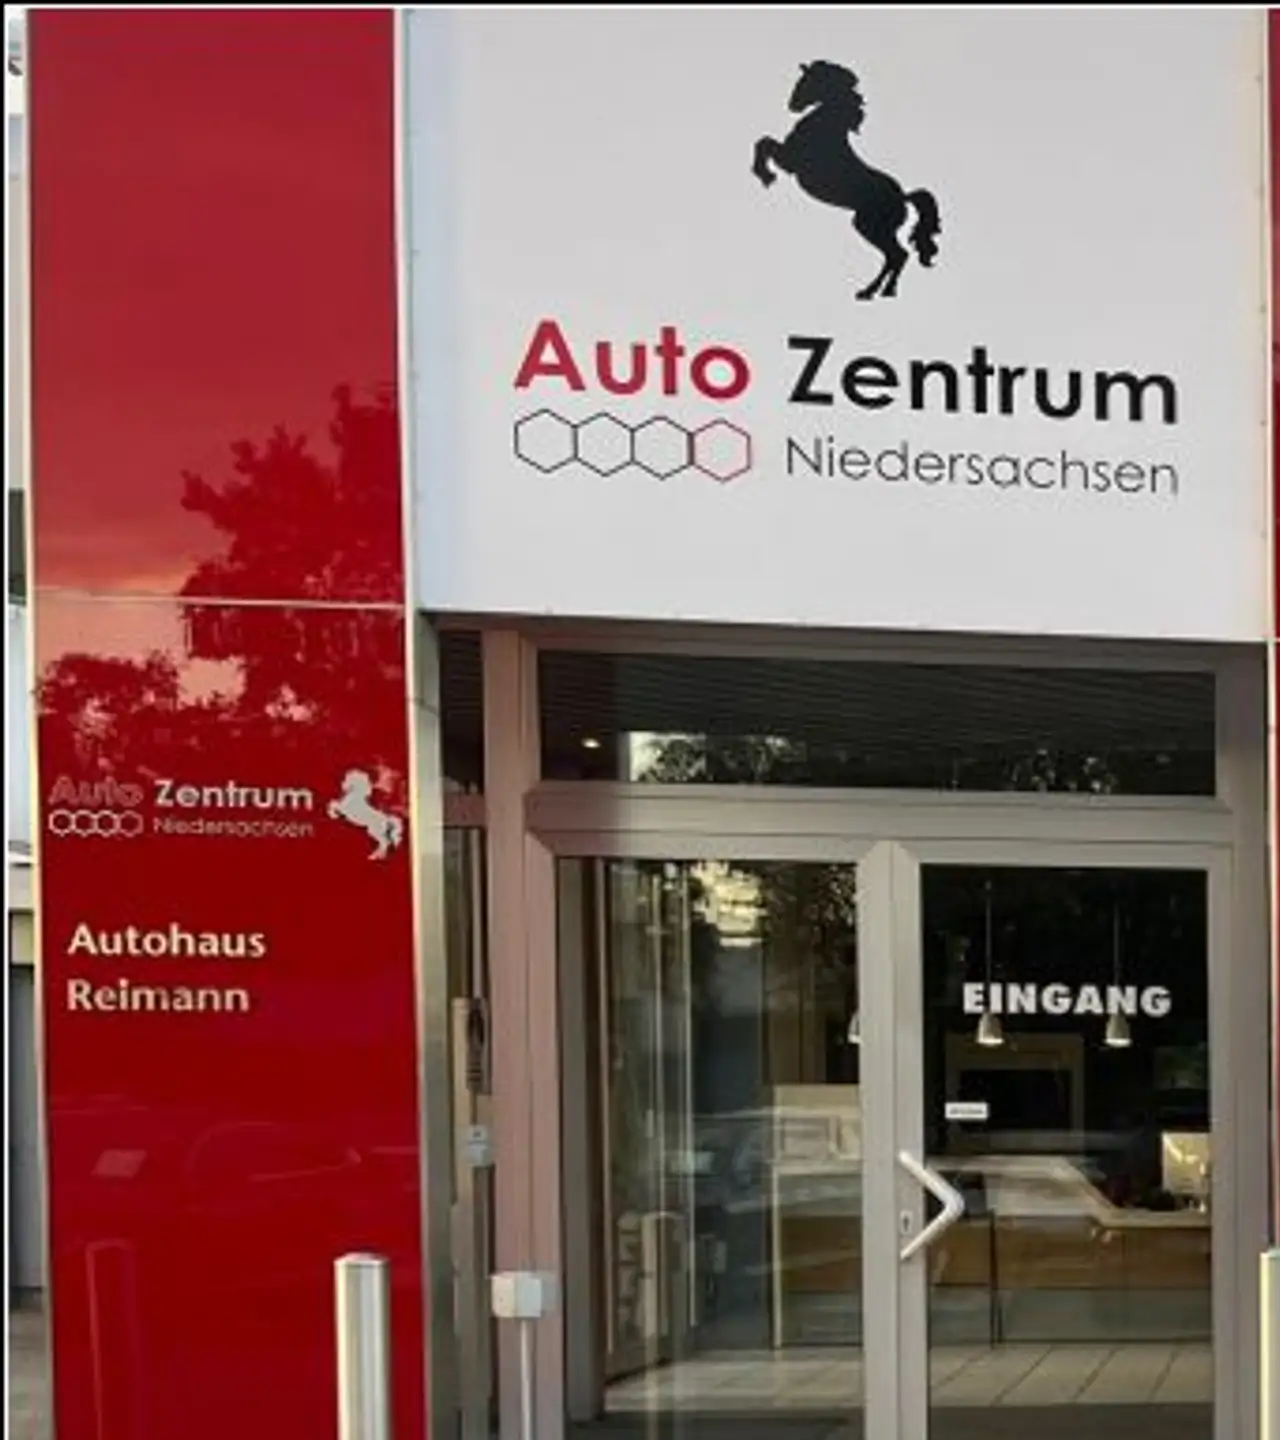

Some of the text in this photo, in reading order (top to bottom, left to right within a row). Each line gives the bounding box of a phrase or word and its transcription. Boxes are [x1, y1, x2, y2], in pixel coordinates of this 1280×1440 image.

[513, 320, 1179, 424] Auto Zentrum
[786, 437, 1179, 494] Niedersachsen
[50, 776, 313, 810] Auto Zentrum
[67, 922, 266, 957] Autohaus
[67, 978, 250, 1011] Reimann
[963, 982, 1172, 1017] EINGANG
